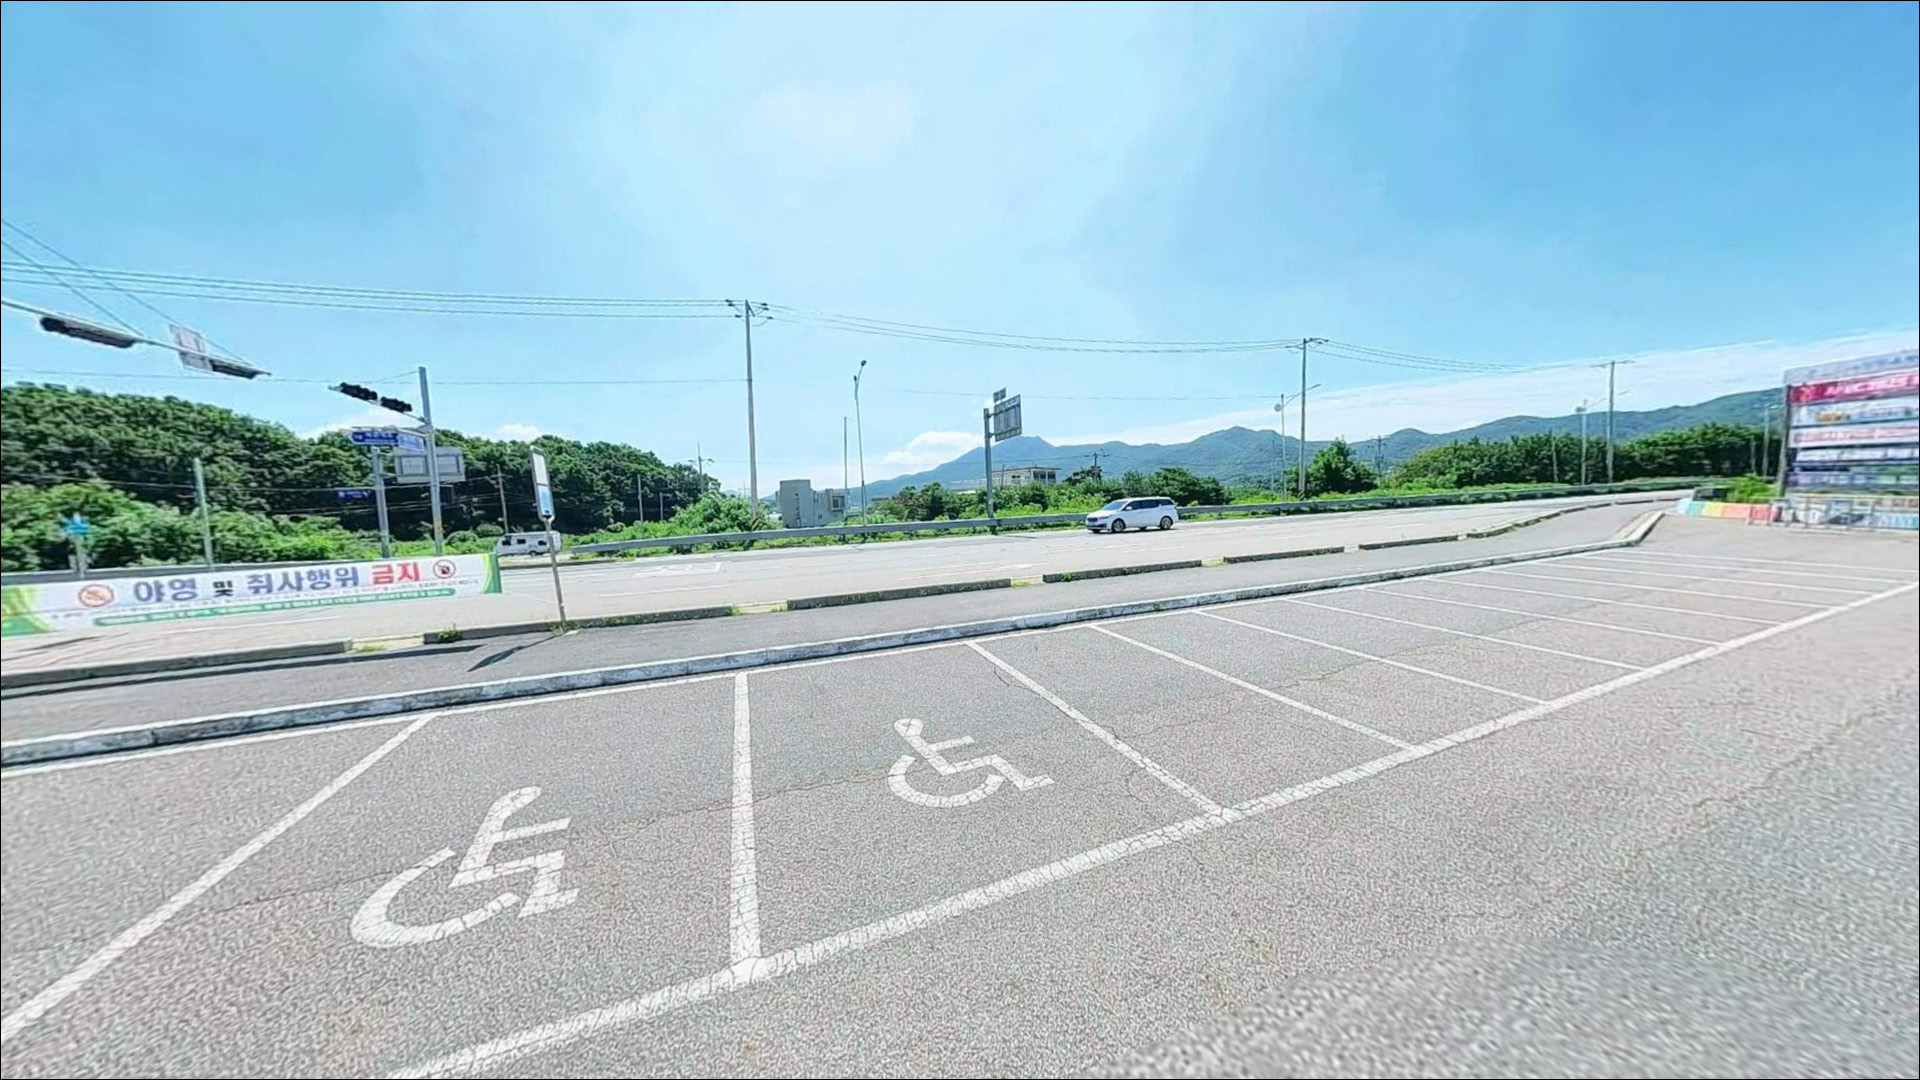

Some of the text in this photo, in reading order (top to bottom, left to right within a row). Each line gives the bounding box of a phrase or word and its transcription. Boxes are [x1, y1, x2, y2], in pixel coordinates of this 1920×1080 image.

[133, 578, 198, 602] 야영
[212, 580, 234, 598] 및
[246, 566, 359, 594] 취사행위
[371, 562, 420, 585] 금지
